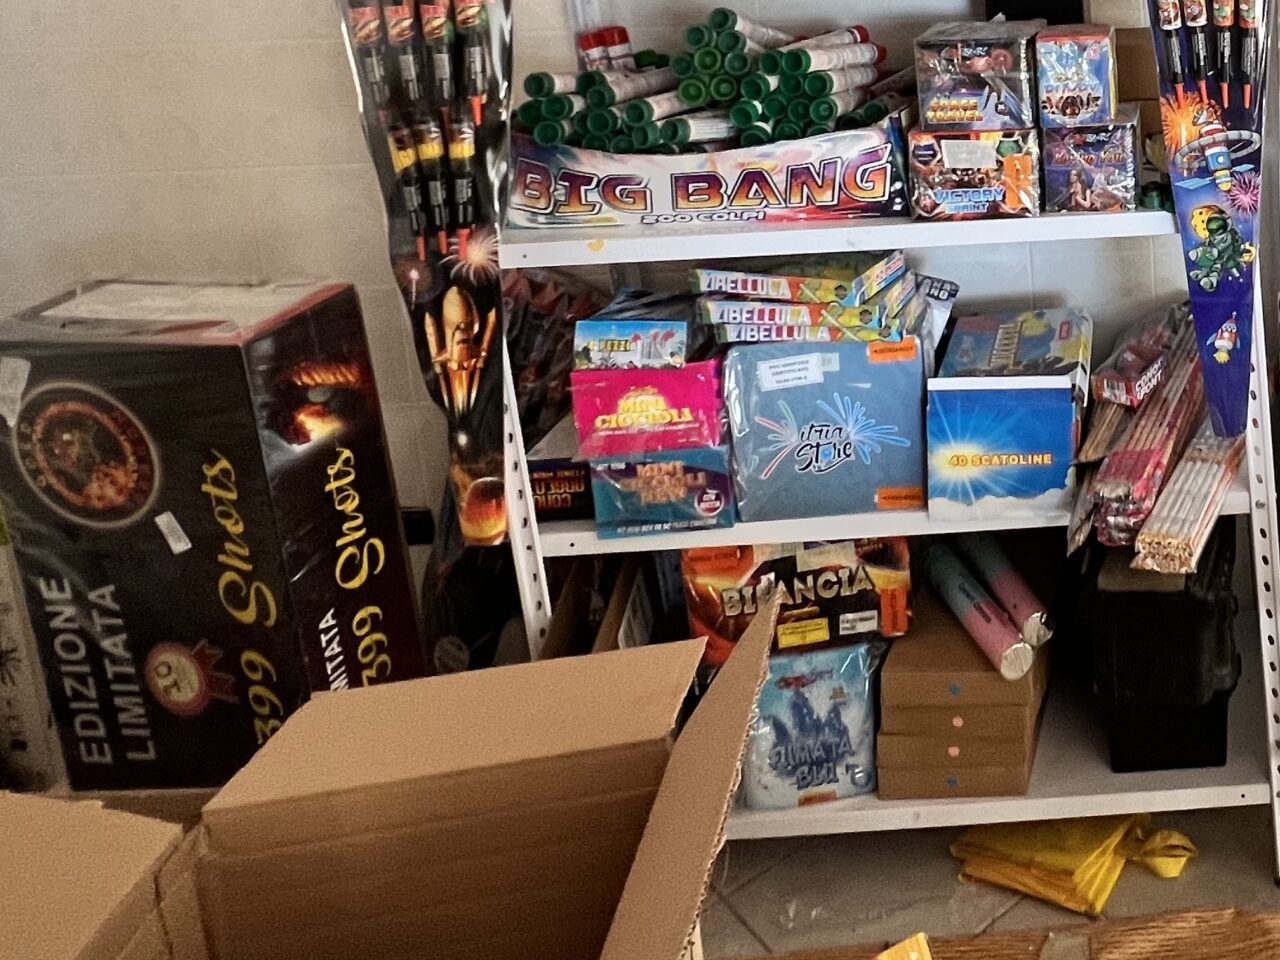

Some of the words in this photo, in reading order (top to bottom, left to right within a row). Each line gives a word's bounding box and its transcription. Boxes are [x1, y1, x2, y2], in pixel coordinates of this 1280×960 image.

[513, 156, 654, 217] BIG
[670, 142, 893, 210] BANG
[933, 186, 1006, 204] VICTORY
[971, 453, 1053, 467] SCATOLINE
[201, 448, 278, 628] Shots
[324, 447, 385, 590] Shots
[38, 577, 113, 766] EDIZIONE
[88, 583, 157, 762] LIMITATA
[318, 607, 350, 691] MITATA
